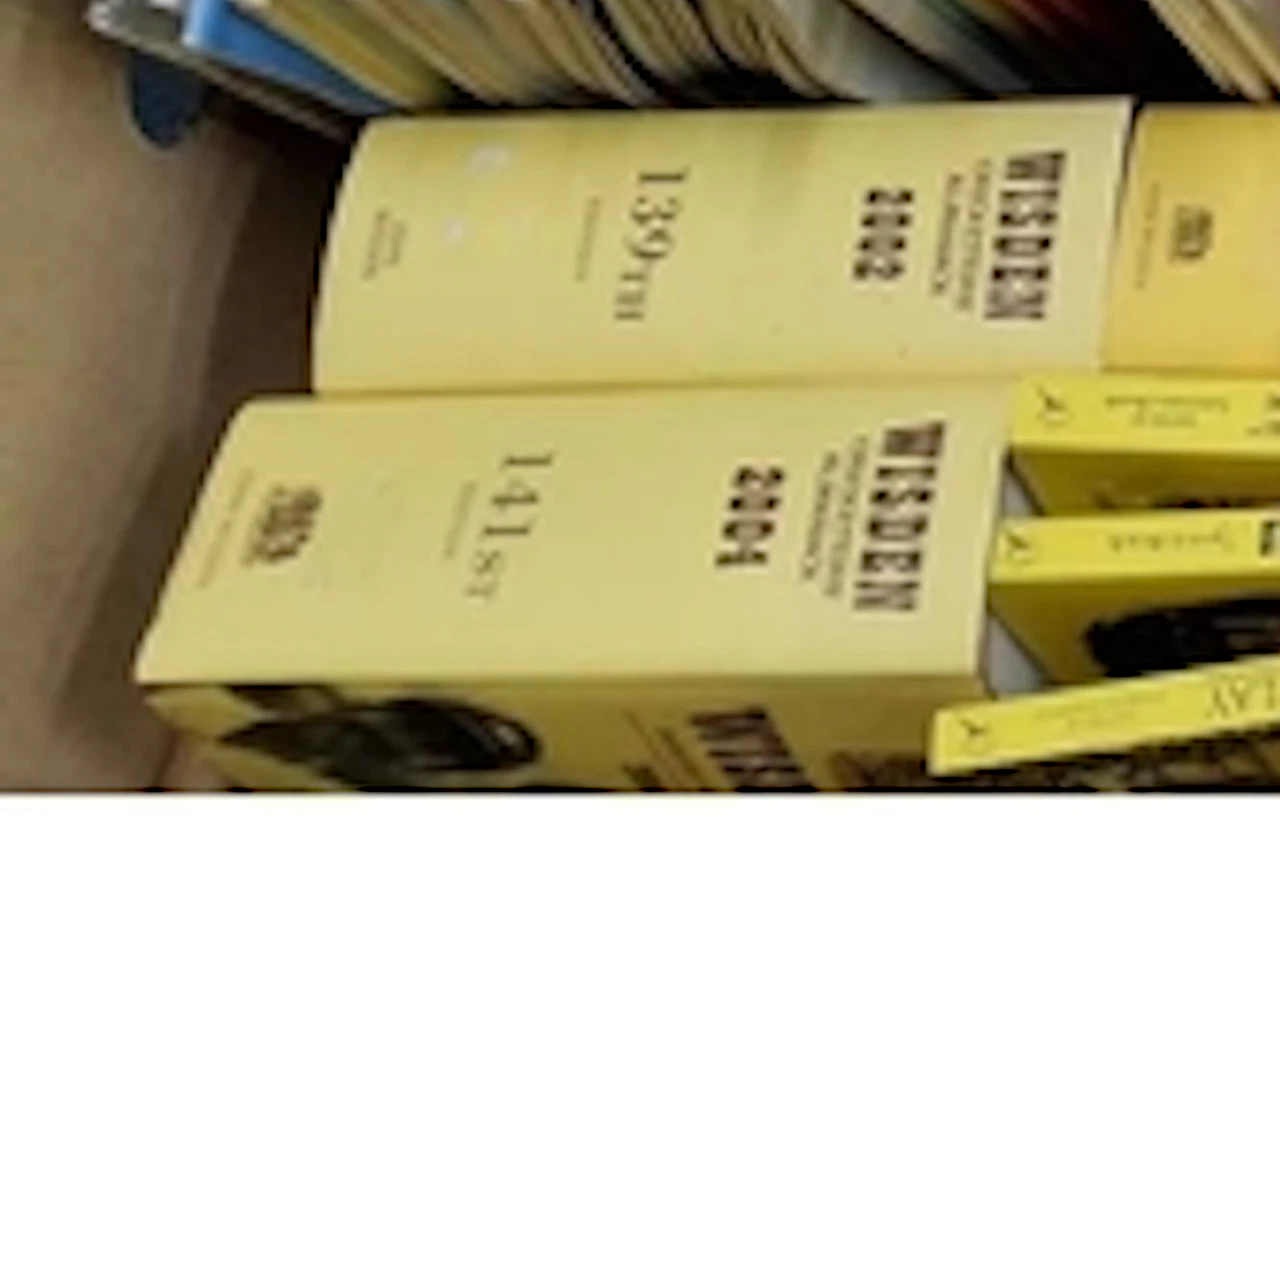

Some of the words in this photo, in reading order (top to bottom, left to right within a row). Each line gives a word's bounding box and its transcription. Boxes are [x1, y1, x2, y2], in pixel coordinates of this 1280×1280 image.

[612, 164, 690, 324] 139TH
[852, 186, 917, 283] 2002
[982, 148, 1068, 324] WISDEN
[463, 449, 552, 605] 141ST
[714, 465, 785, 569] 2004
[852, 419, 946, 614] WISDEN
